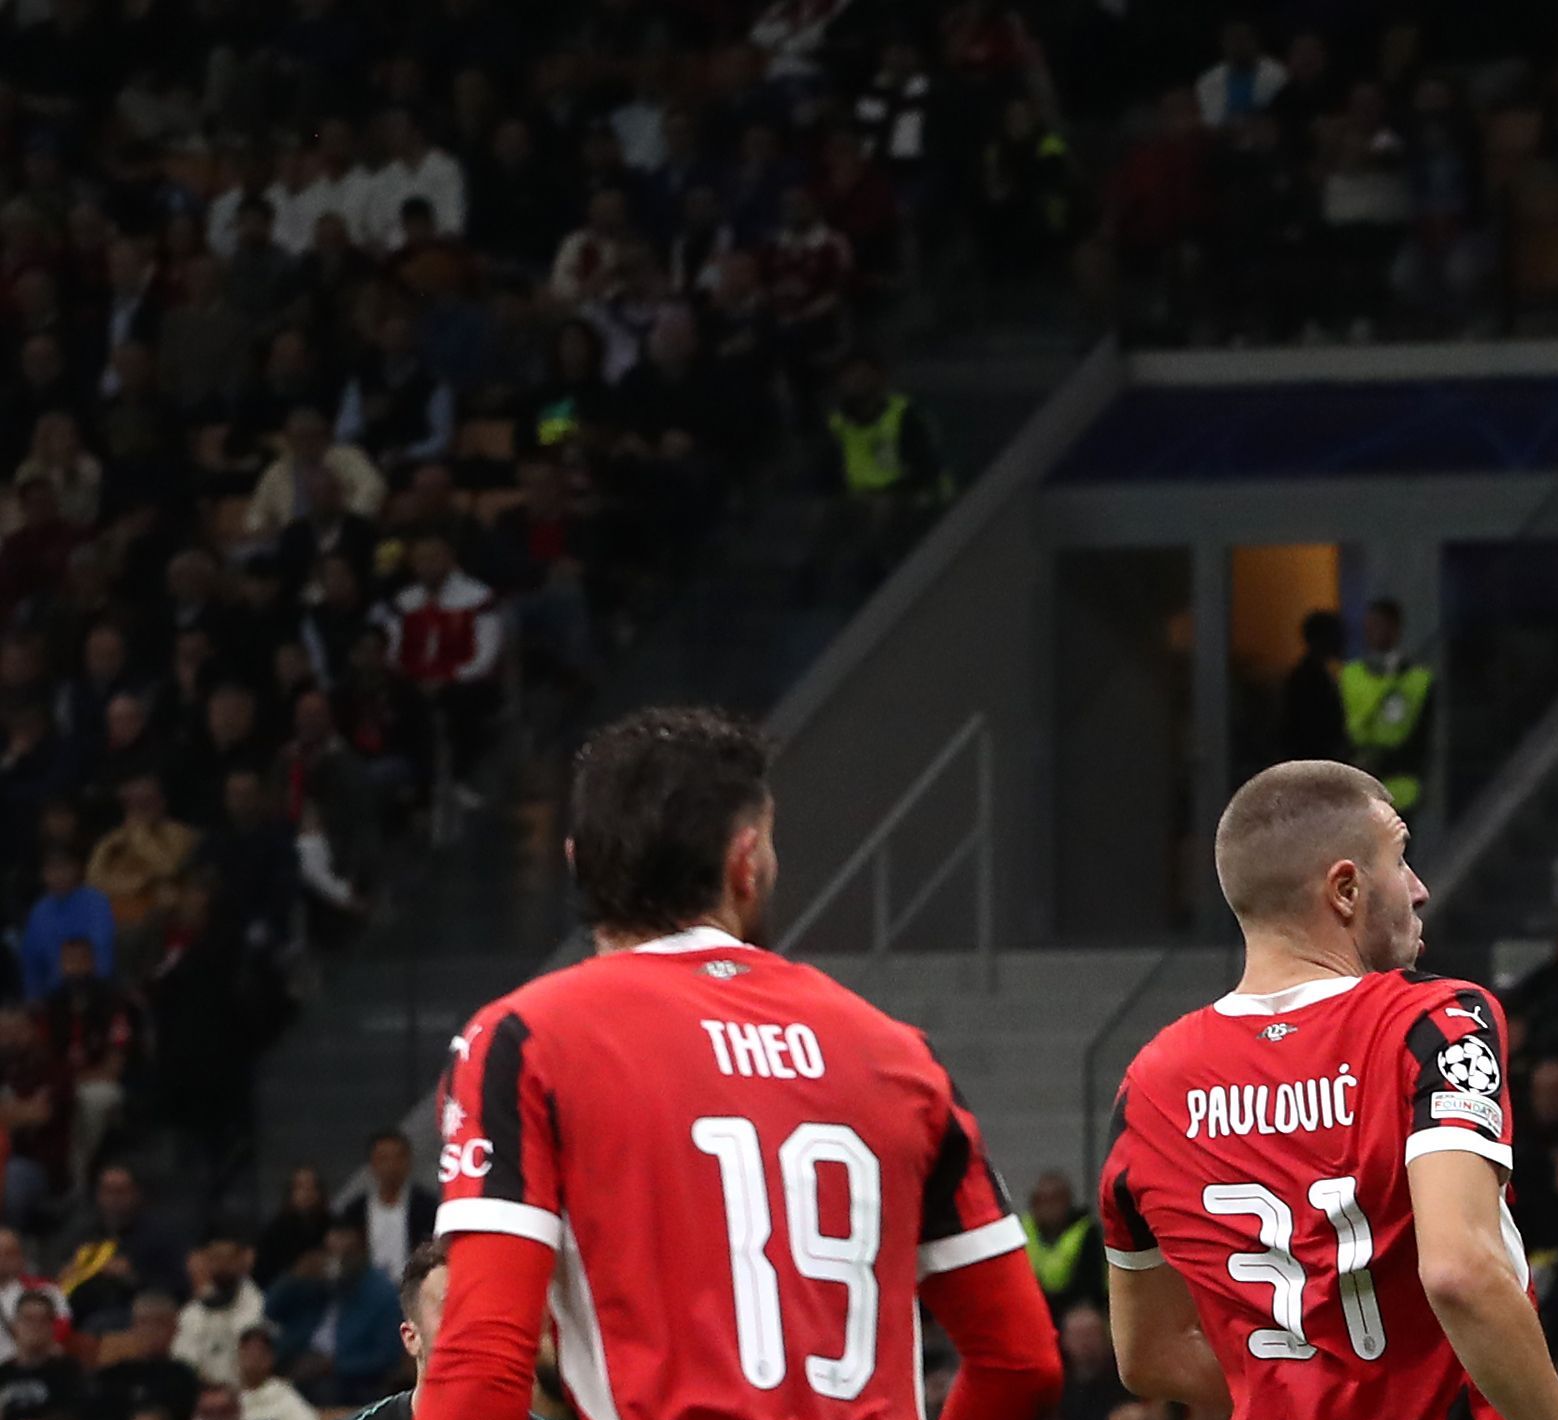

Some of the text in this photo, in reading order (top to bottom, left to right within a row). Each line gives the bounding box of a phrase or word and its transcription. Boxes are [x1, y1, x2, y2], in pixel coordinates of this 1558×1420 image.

[702, 1018, 825, 1080] THEO
[1185, 1063, 1358, 1138] PAVLOVIĆ
[437, 1137, 494, 1183] SC
[691, 1115, 881, 1400] 19
[1201, 1176, 1386, 1361] 31
